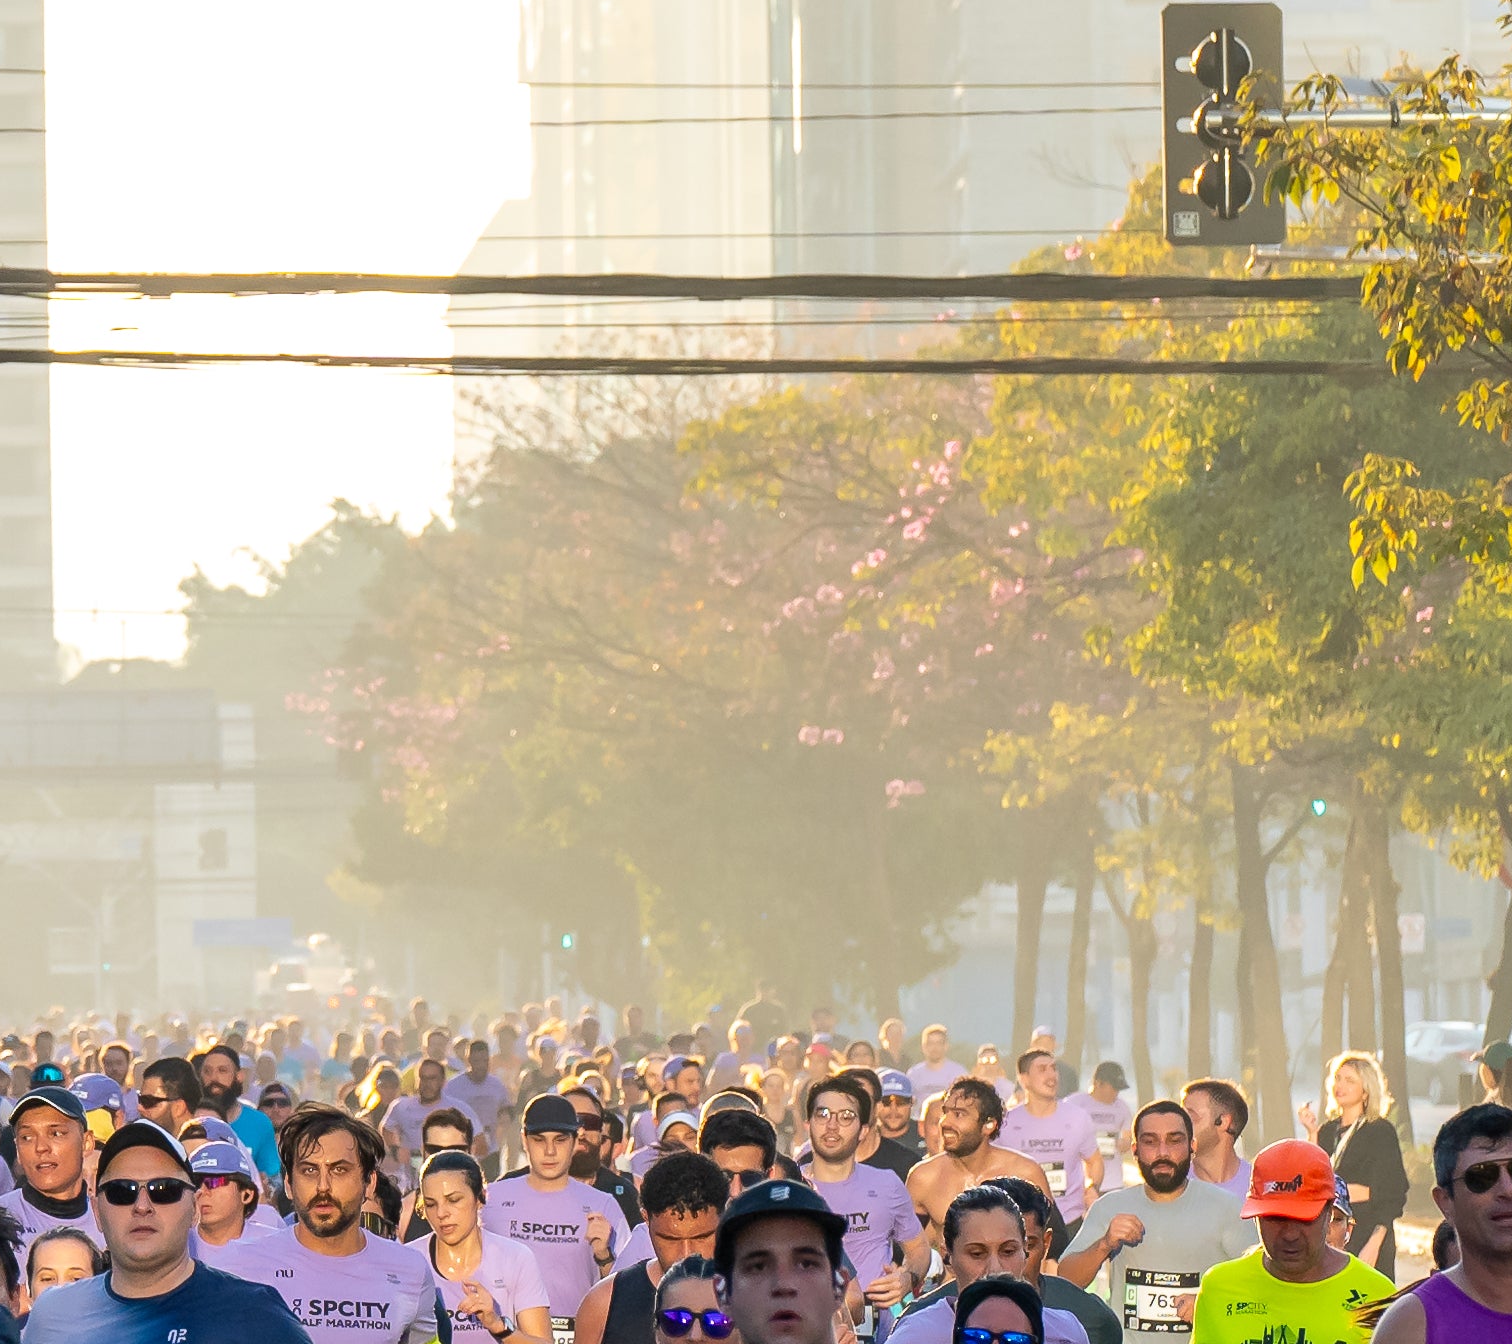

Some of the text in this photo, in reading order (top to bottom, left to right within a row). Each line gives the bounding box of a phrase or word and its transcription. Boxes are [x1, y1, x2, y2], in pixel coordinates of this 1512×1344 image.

[521, 1222, 580, 1236] SPCITY
[275, 1268, 294, 1278] nu
[308, 1299, 391, 1319] SPCITY
[1236, 1302, 1268, 1310] SPCITY
[301, 1318, 391, 1331] ALF MARATHON
